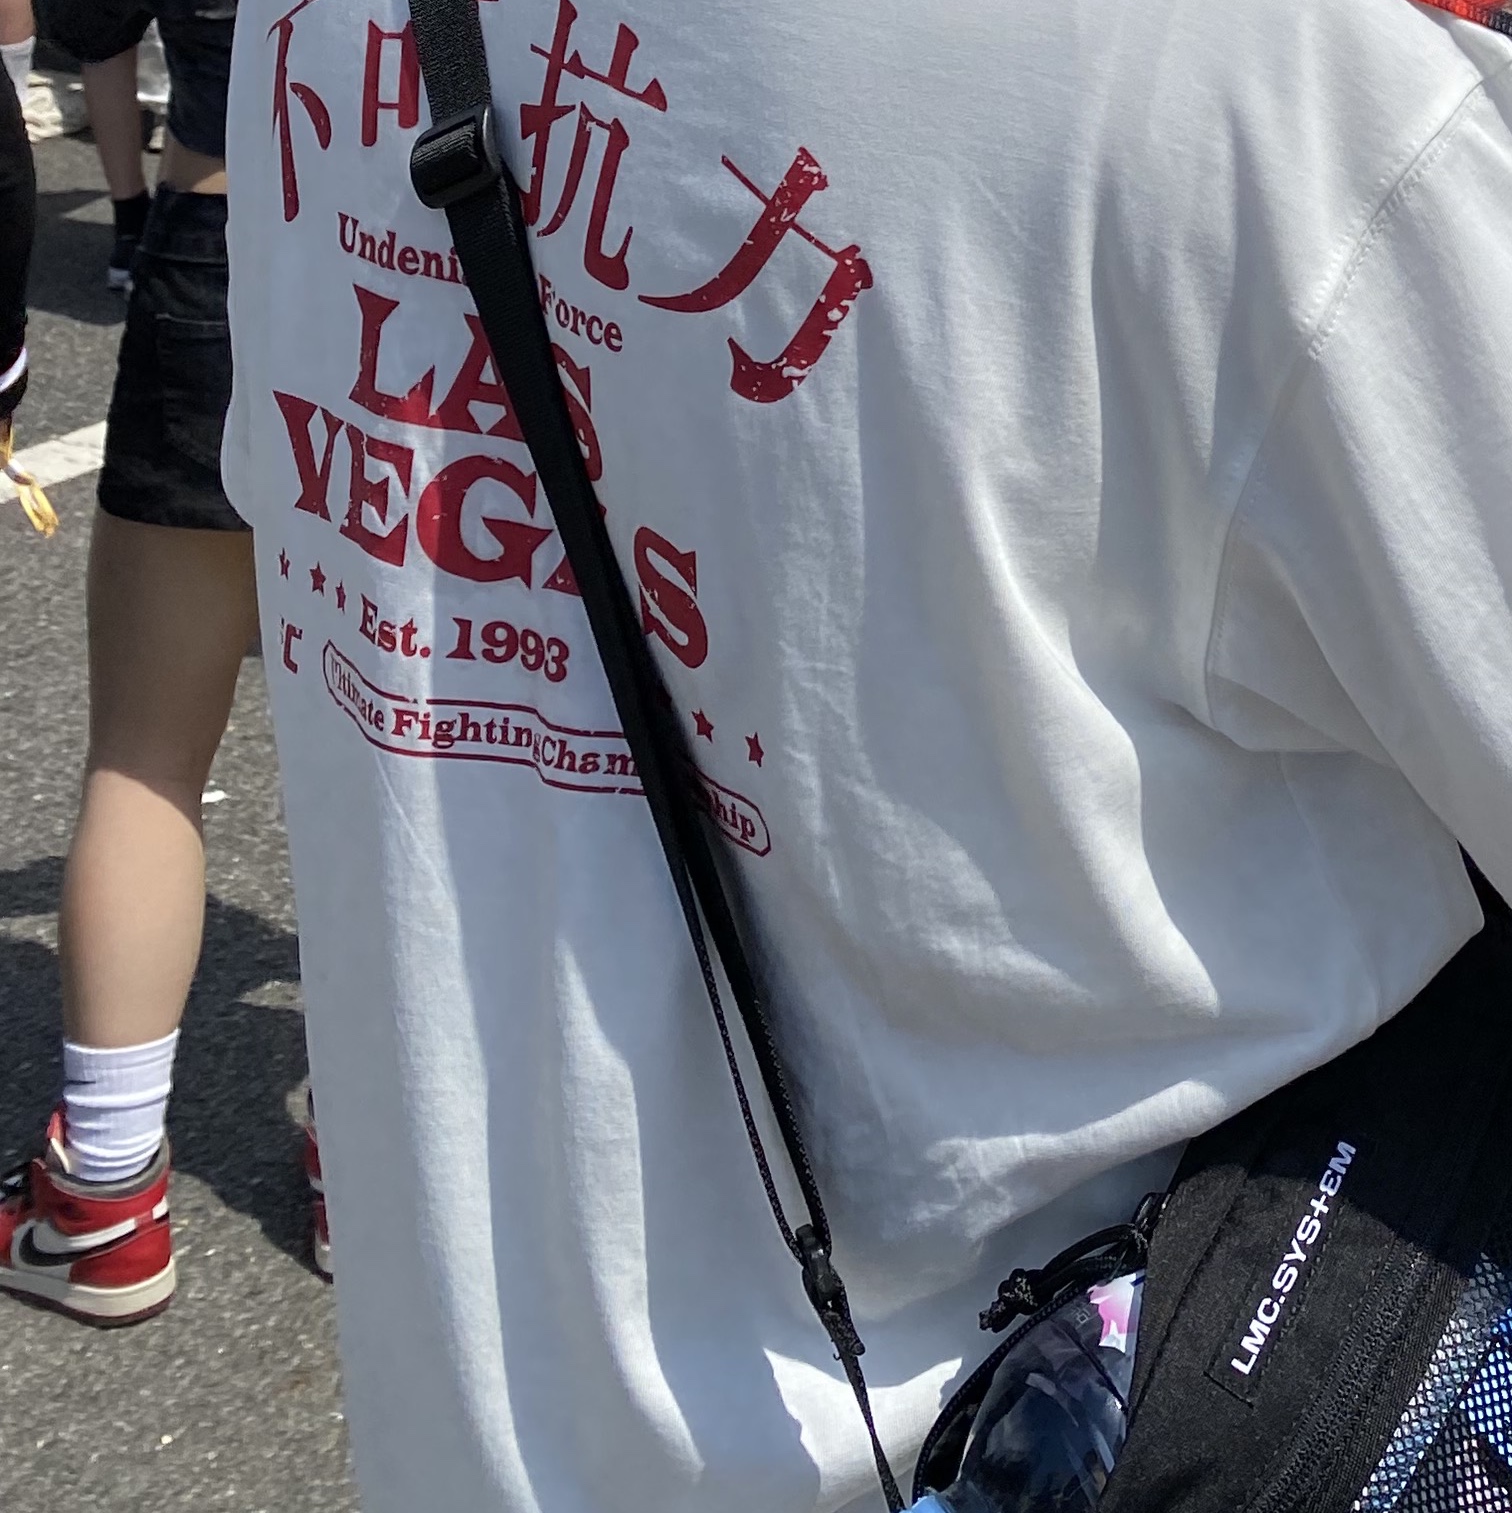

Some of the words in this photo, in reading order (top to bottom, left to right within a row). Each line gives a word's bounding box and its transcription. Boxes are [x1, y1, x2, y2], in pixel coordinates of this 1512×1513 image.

[337, 211, 466, 285] Undeni
[536, 272, 624, 353] Force
[358, 592, 432, 660] Est.
[445, 616, 571, 684] 1993
[390, 707, 543, 764] Fighting
